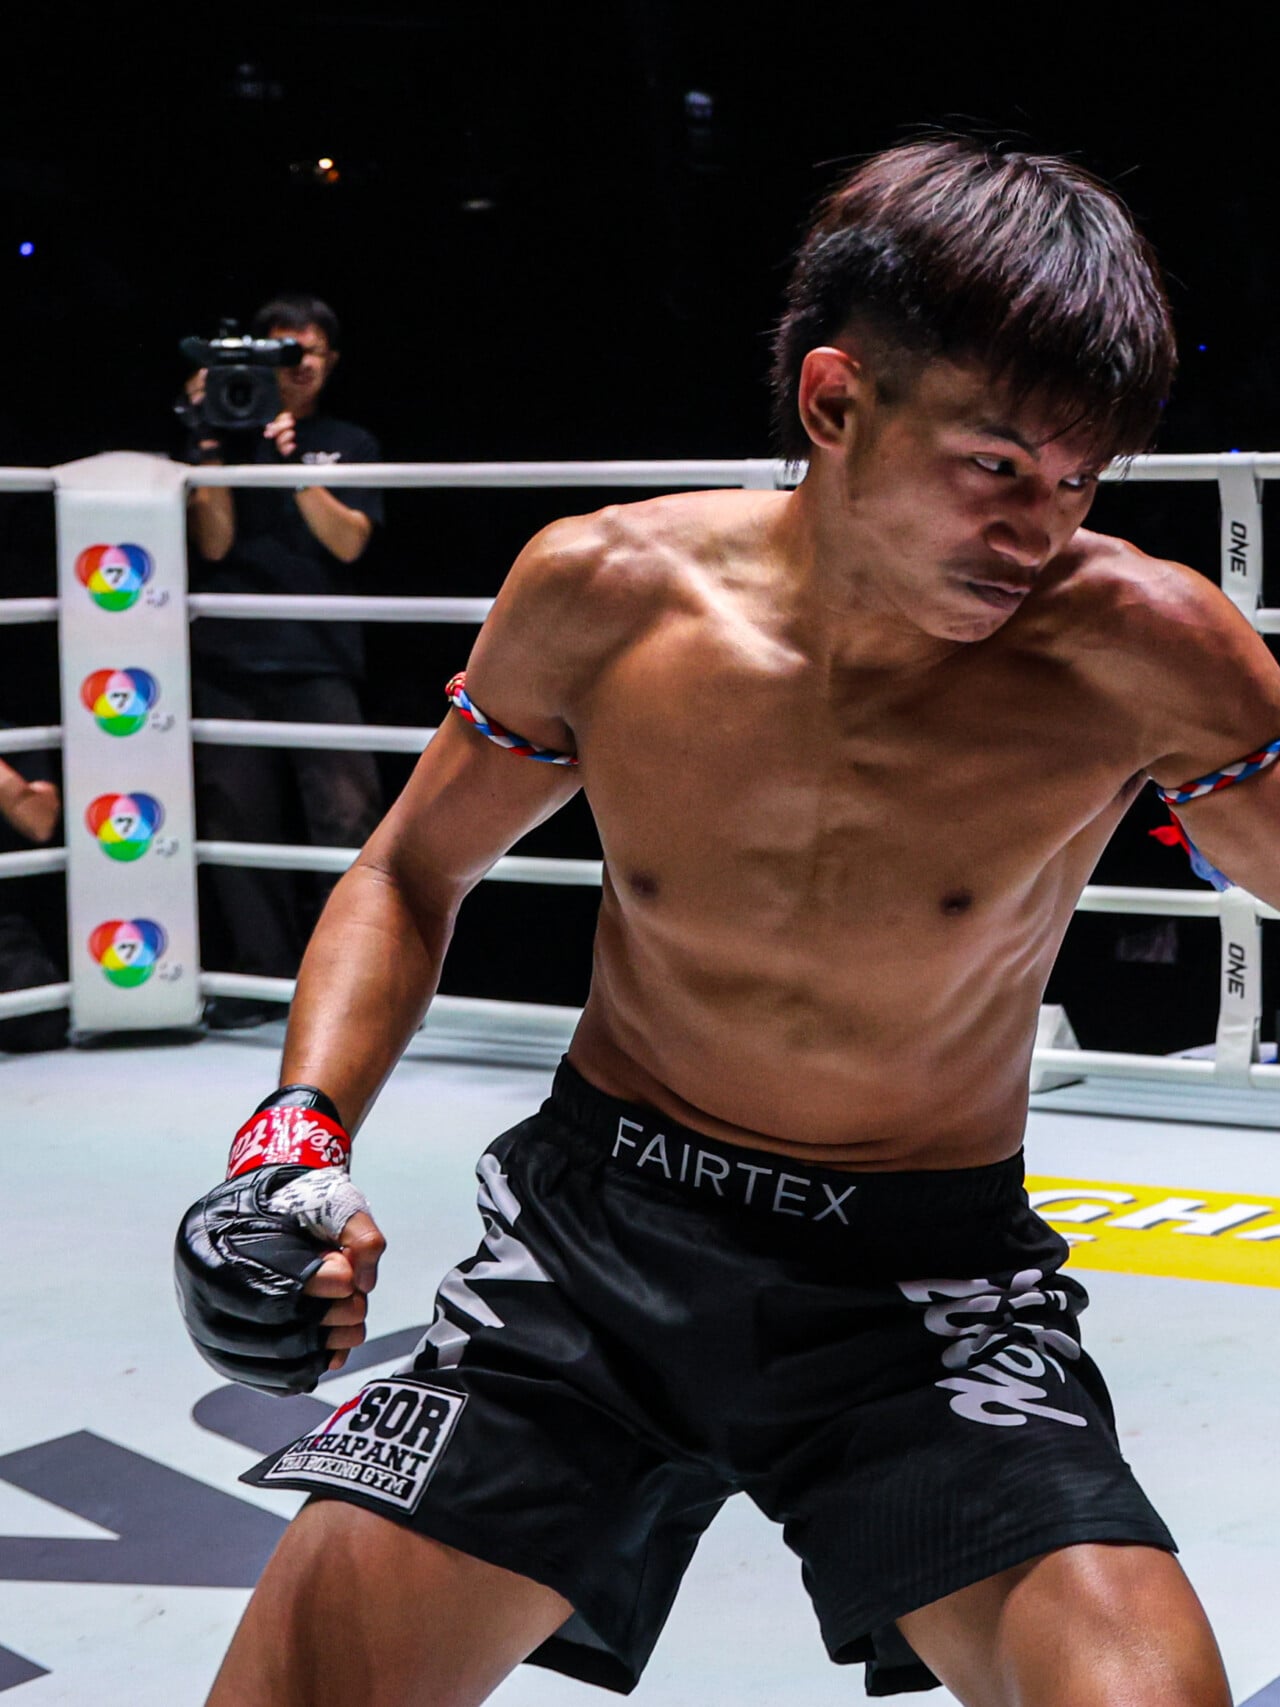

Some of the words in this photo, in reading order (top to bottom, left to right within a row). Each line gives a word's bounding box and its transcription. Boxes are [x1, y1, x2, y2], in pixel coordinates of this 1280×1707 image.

[1227, 520, 1250, 577] ONE
[1226, 942, 1247, 999] ONE
[611, 1116, 857, 1225] FAIRTEX
[348, 1386, 451, 1453] SOR
[303, 1456, 363, 1481] BOXING
[361, 1467, 408, 1496] GYM
